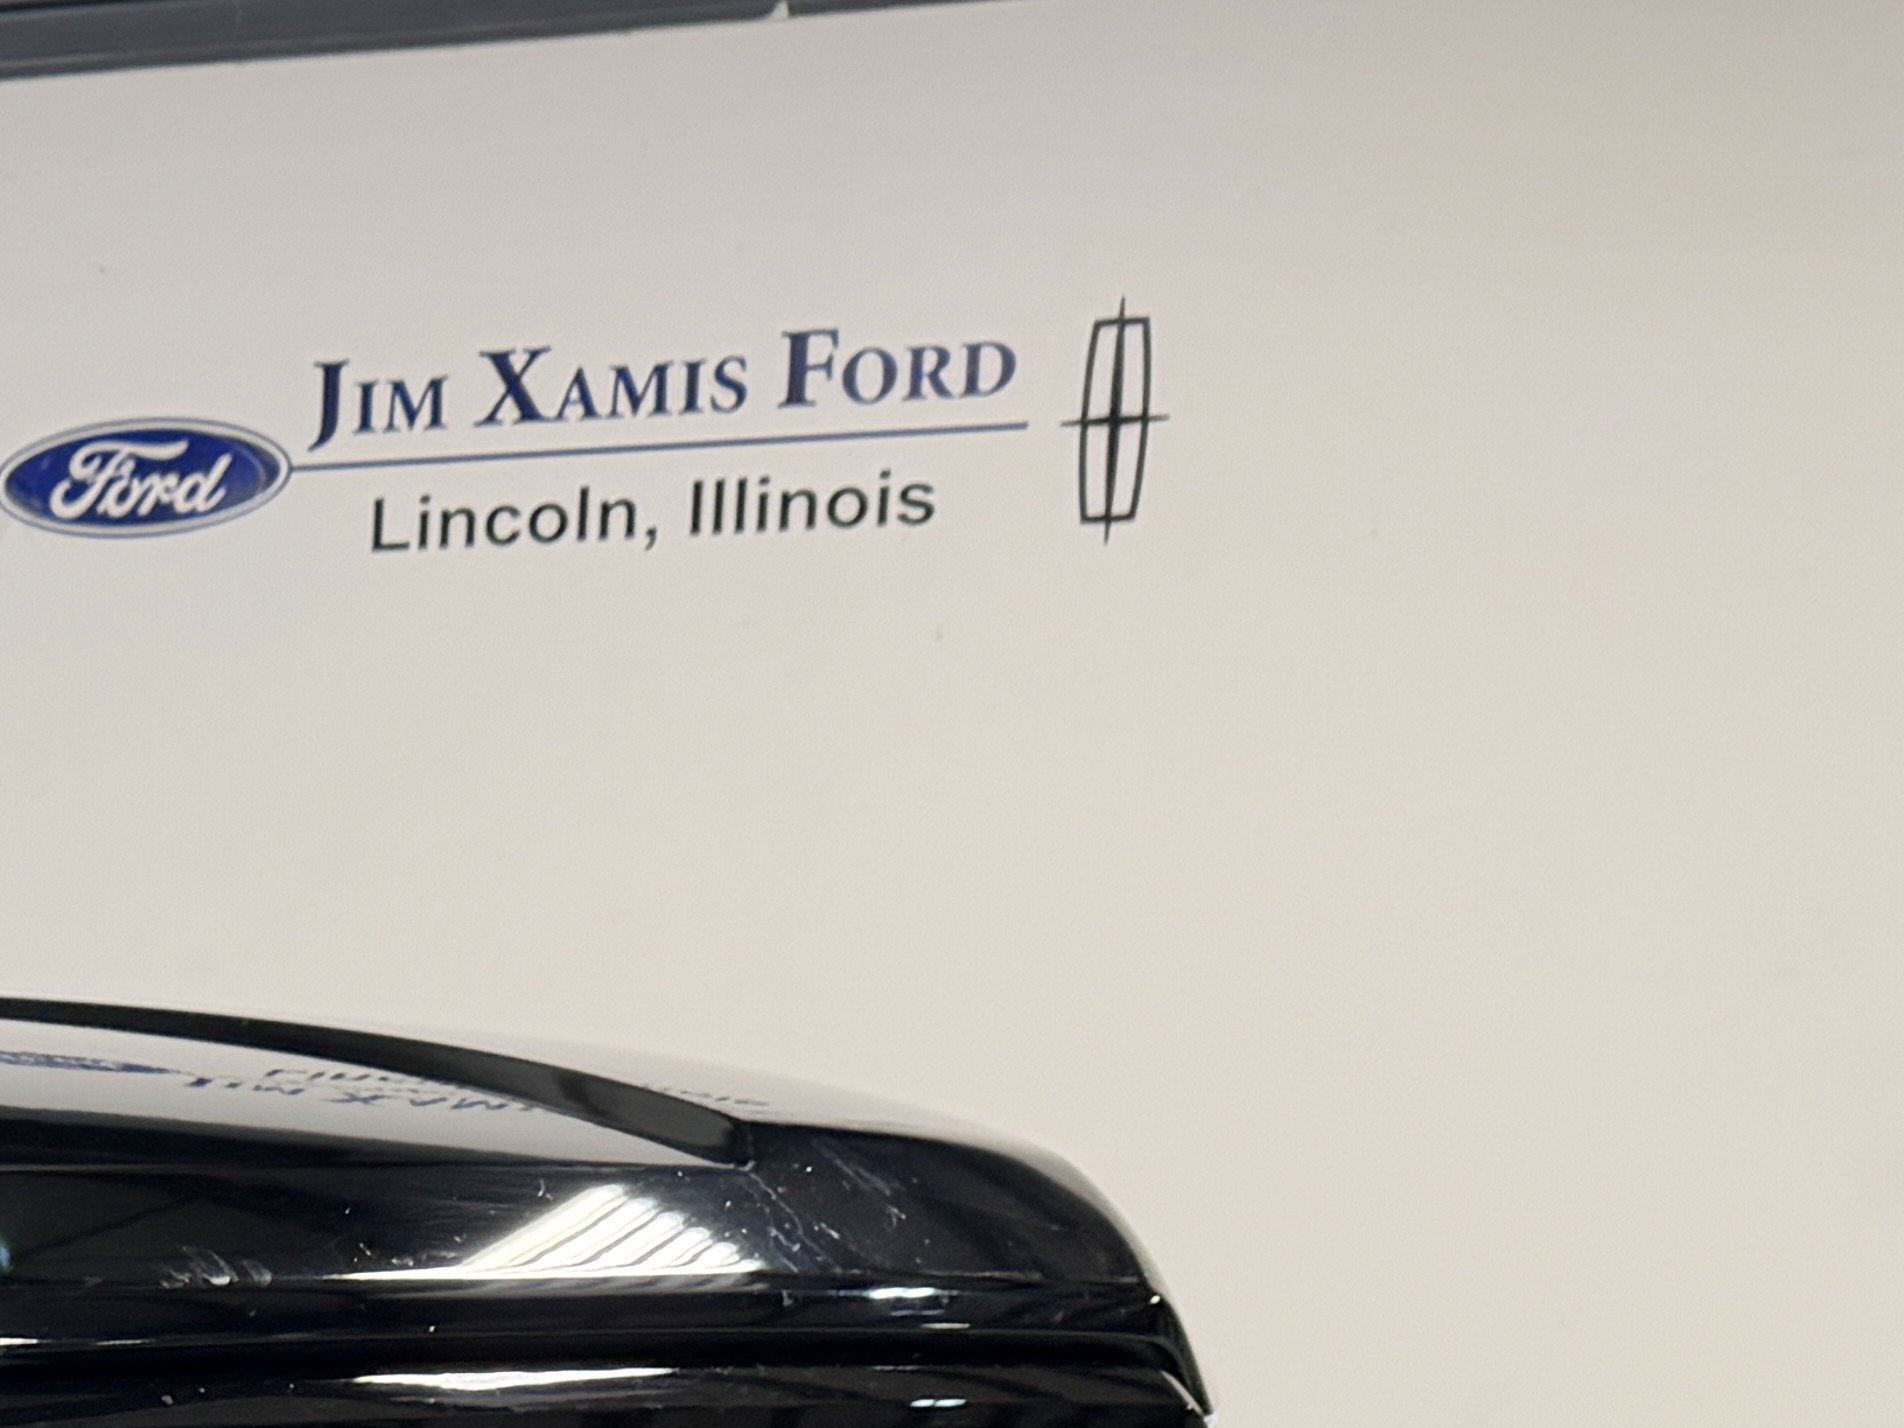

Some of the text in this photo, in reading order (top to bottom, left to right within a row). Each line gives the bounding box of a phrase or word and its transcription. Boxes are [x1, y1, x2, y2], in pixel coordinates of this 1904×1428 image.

[307, 327, 1018, 452] JIM XAMIS FORD
[48, 438, 234, 520] Ford
[371, 467, 936, 552] Lincoln, Illinois
